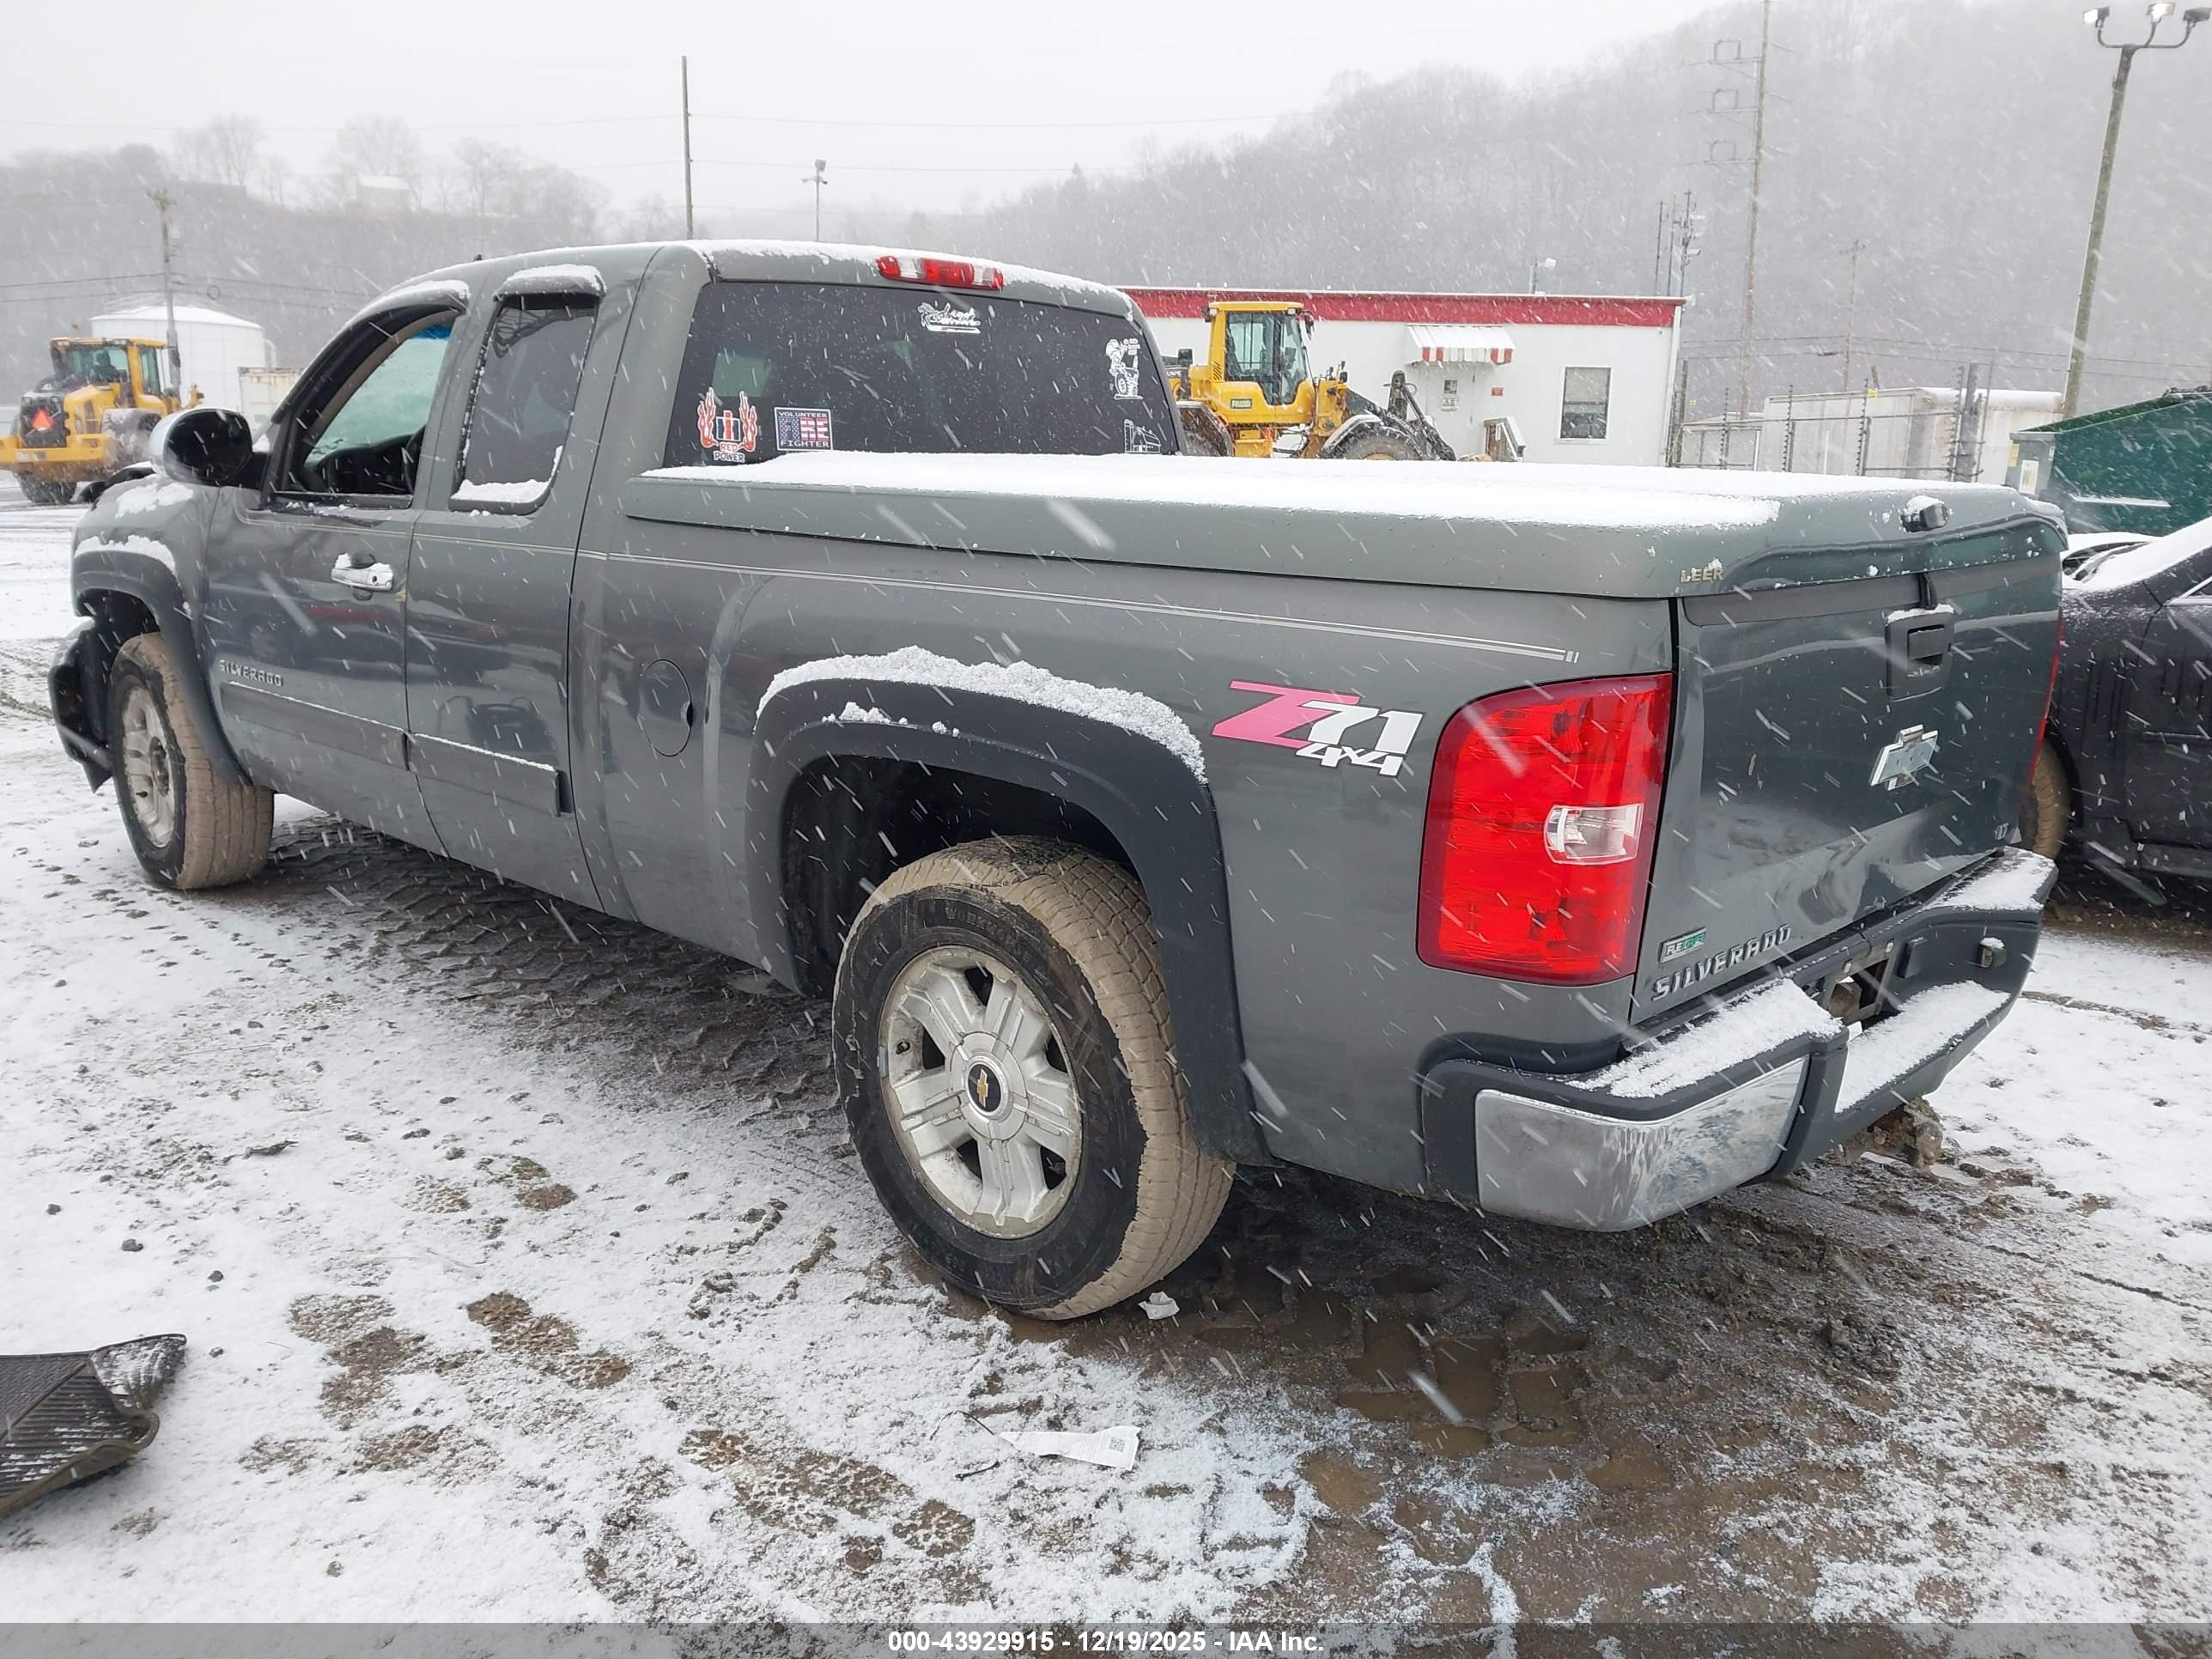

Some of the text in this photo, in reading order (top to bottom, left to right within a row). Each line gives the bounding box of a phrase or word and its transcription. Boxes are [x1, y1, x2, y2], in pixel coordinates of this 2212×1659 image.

[778, 416, 830, 441] FIRE
[714, 452, 744, 462] POWER
[720, 442, 739, 453] RED
[1680, 564, 1724, 583] LEER
[219, 659, 283, 687] SILVERADO
[1211, 679, 1425, 755] Z71
[1651, 922, 1792, 1002] SILVERADO
